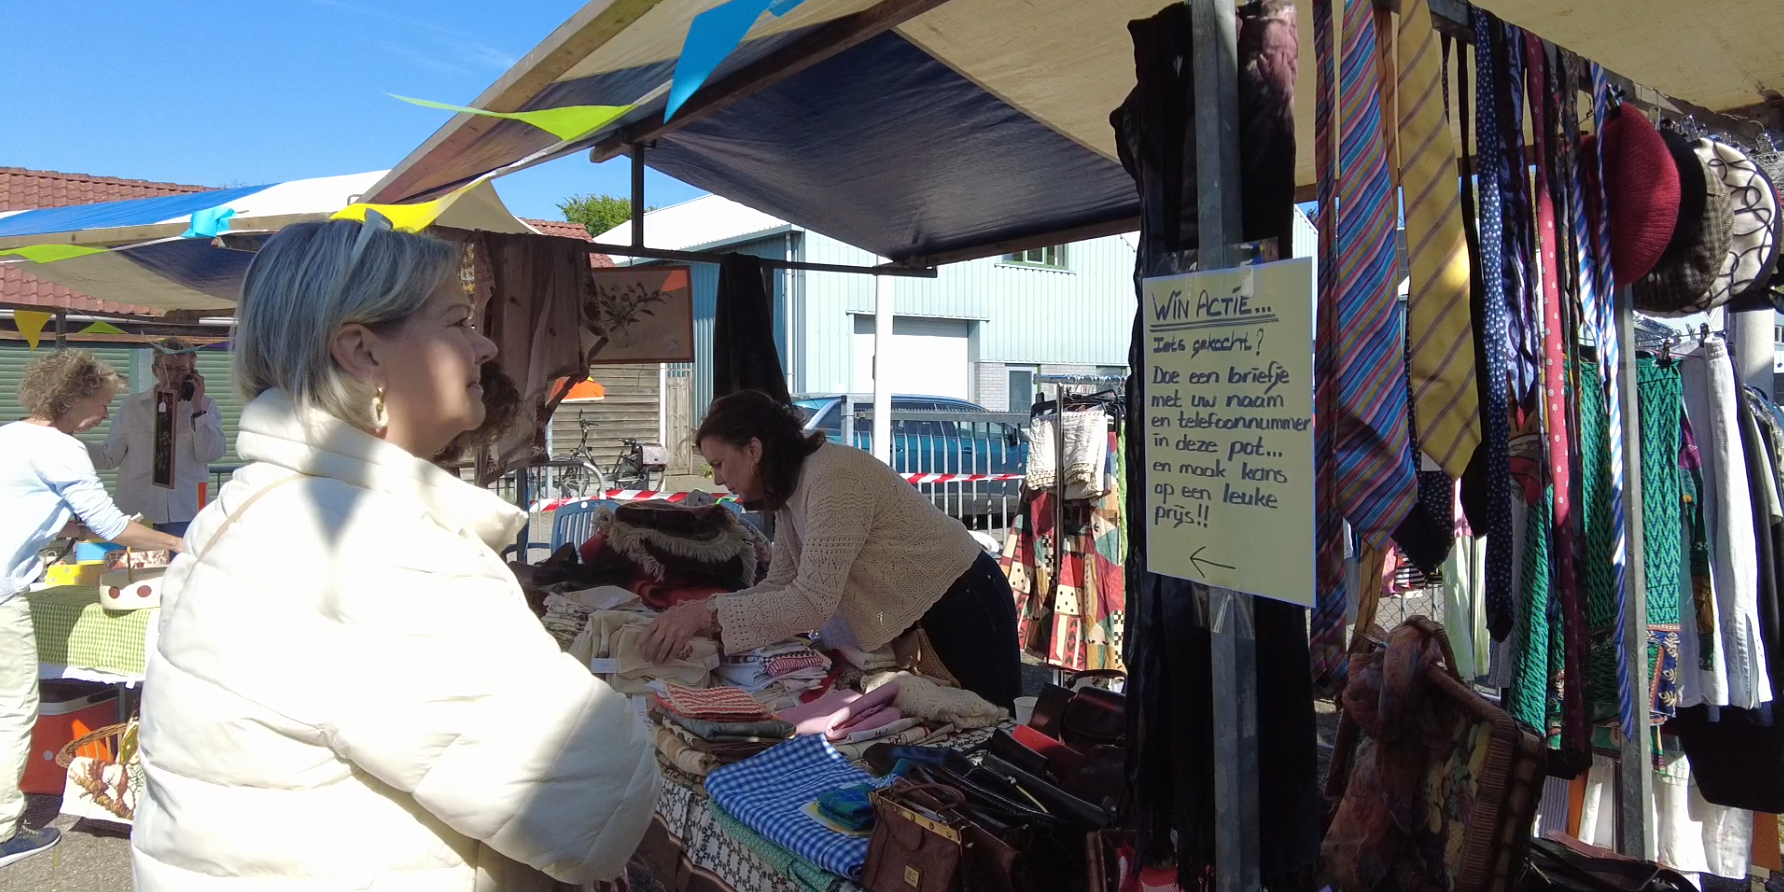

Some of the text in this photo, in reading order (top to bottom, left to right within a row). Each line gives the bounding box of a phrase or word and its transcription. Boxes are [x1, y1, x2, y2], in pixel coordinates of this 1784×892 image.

[1151, 290, 1190, 321] WIN
[1152, 360, 1290, 395] Doe een briefje
[1151, 389, 1284, 408] met uw naam
[1151, 410, 1312, 432] en telefoonnummer
[1152, 433, 1283, 461] in deze pot...
[1153, 459, 1287, 484] en maak kans
[1154, 482, 1278, 509] op een leuke
